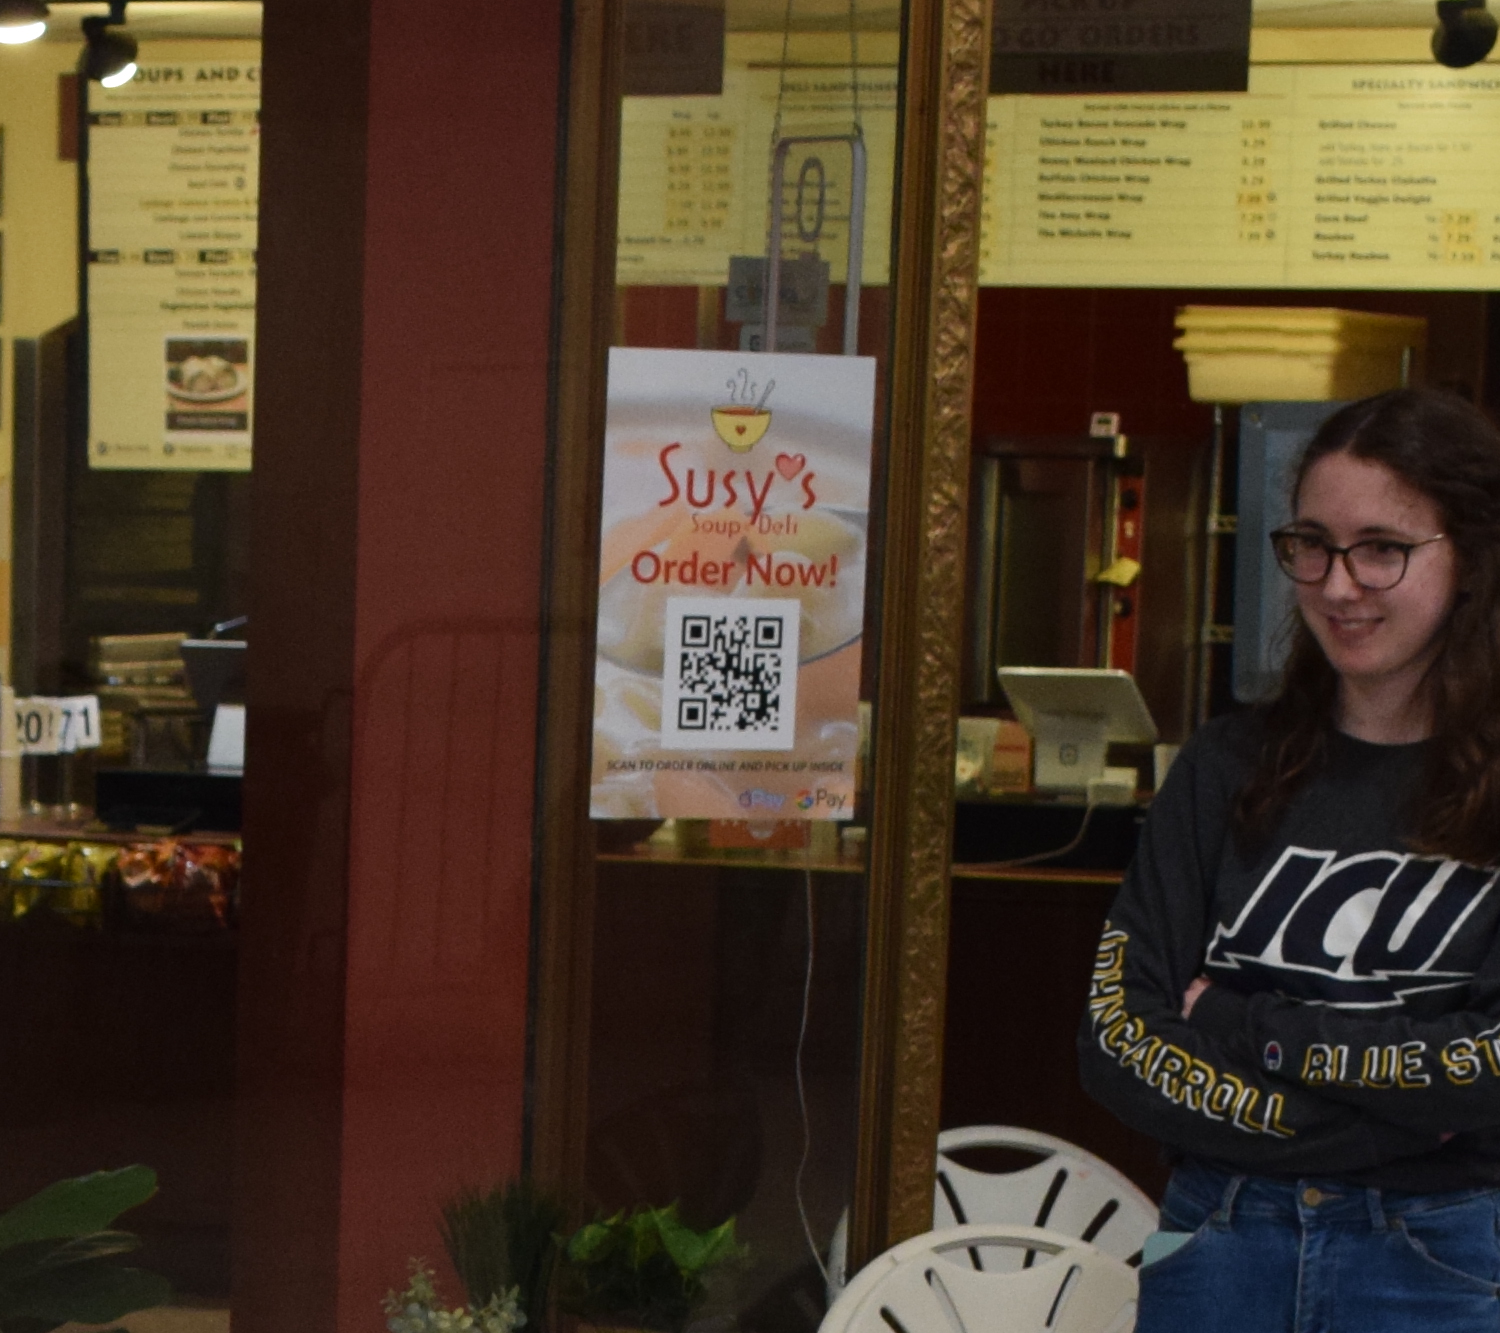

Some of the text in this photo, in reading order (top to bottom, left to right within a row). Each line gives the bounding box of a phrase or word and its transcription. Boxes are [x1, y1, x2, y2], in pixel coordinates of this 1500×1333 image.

[691, 513, 741, 538] Soup
[631, 550, 838, 587] Order Now!
[1100, 1017, 1295, 1138] CARROLL
[1302, 1041, 1431, 1088] BLUE
